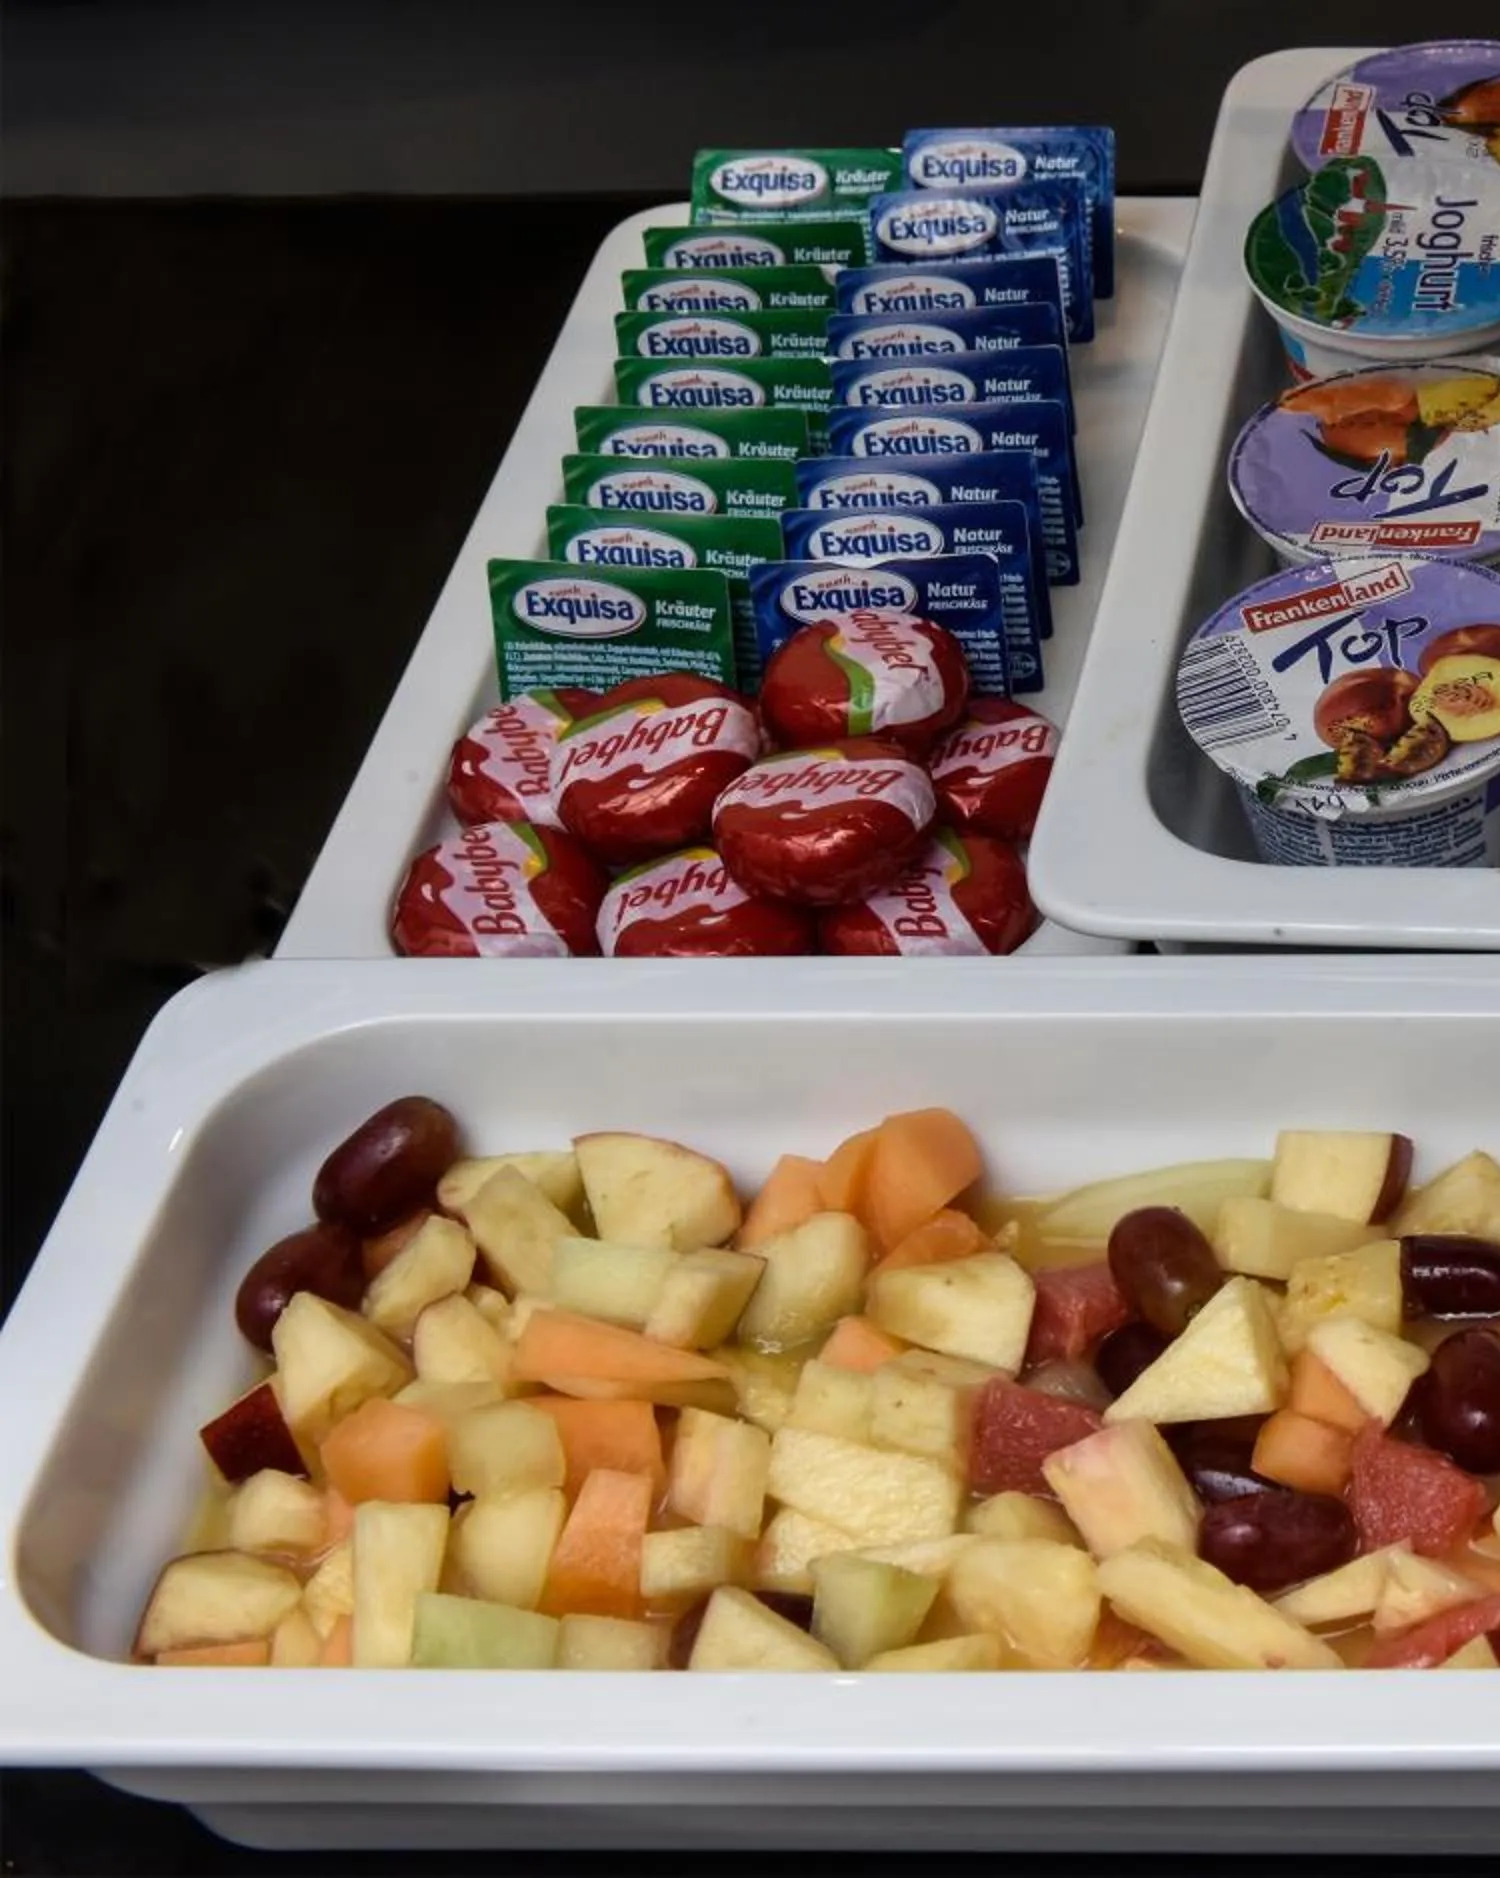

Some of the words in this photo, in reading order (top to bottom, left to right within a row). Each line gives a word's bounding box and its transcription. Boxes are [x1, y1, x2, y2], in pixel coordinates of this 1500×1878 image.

[1374, 91, 1464, 157] Top
[922, 151, 1017, 183] Exquisa
[1035, 154, 1079, 170] Natur
[721, 165, 816, 196] Exquisa
[1005, 208, 1050, 223] Natur
[889, 212, 987, 244] Exquisa
[794, 247, 852, 262] Kräuter
[1412, 196, 1479, 312] Joghurt
[769, 292, 829, 307] Kräuter
[984, 288, 1030, 302] Natur
[647, 329, 751, 358] Exquisa
[770, 334, 829, 349] Kräuter
[974, 335, 1022, 350] Natur
[773, 385, 833, 401] Kräuter
[984, 377, 1033, 393] Natur
[991, 432, 1040, 446] Natur
[738, 442, 799, 458] Kräuter
[951, 486, 999, 501] Natur
[1329, 449, 1490, 519] Top
[726, 489, 787, 507] Kräuter
[820, 526, 932, 559] Exquisa
[953, 528, 1003, 544] Natur
[1319, 523, 1474, 544] Frankenland
[792, 580, 906, 612] Exquisa
[927, 583, 977, 598] Natur
[525, 591, 635, 625] Exquisa
[655, 600, 717, 620] Kräuter
[1250, 571, 1402, 631] Frankenland
[1271, 612, 1430, 686] Top
[556, 707, 729, 790] Babybel
[452, 824, 530, 936] Babybe
[613, 861, 730, 932] bybel
